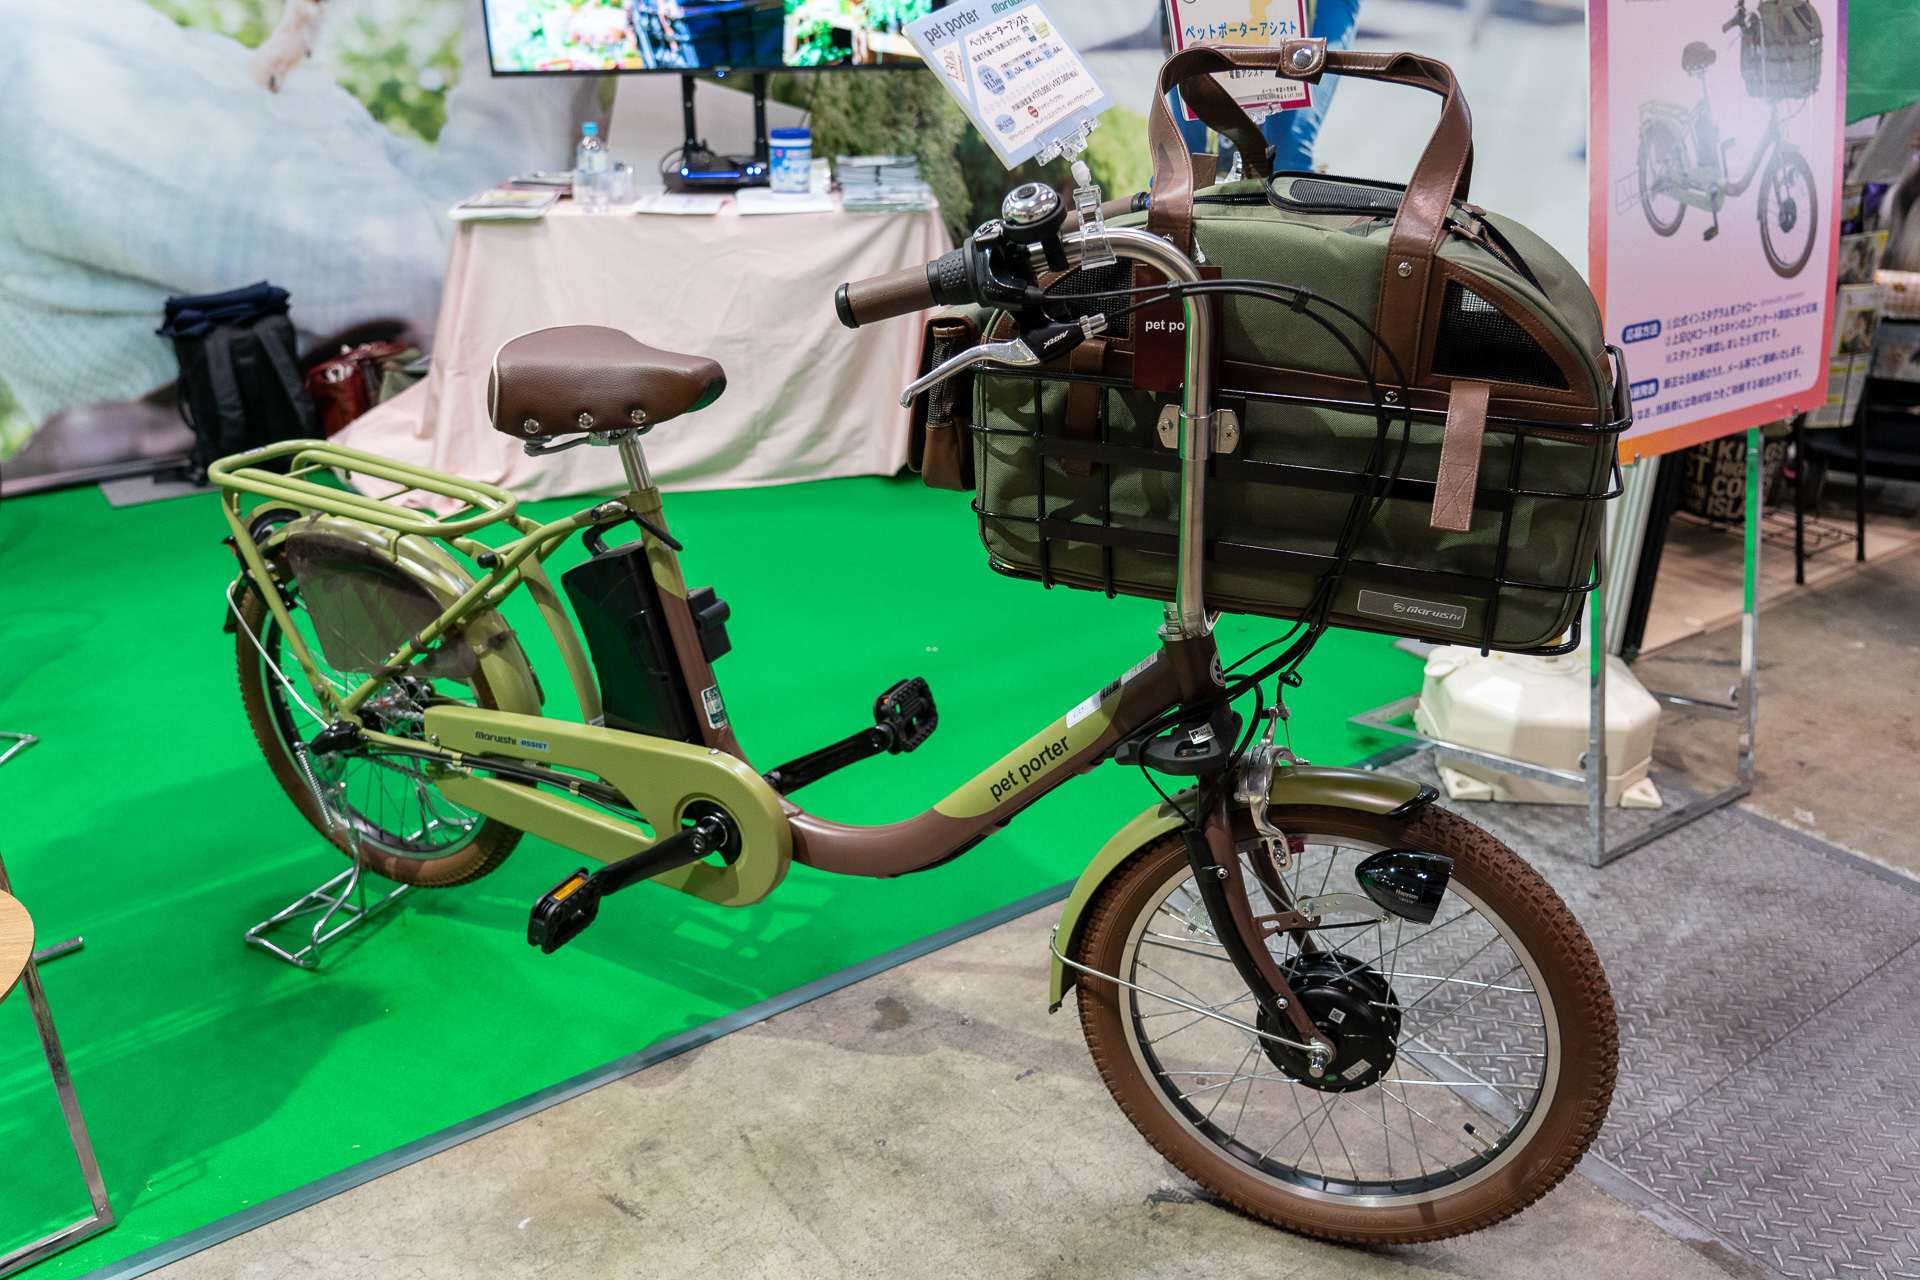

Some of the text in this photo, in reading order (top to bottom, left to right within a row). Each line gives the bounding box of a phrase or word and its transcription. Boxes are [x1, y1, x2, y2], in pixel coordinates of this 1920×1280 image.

[923, 8, 980, 47] pet porter
[1185, 20, 1297, 41] ペットポーターアシスト
[1228, 69, 1265, 80] 電動アシスト
[1145, 319, 1165, 332] pet
[1406, 605, 1462, 621] Maruishi
[475, 731, 548, 749] Maruishi ASSIST
[989, 736, 1070, 802] pet porter
